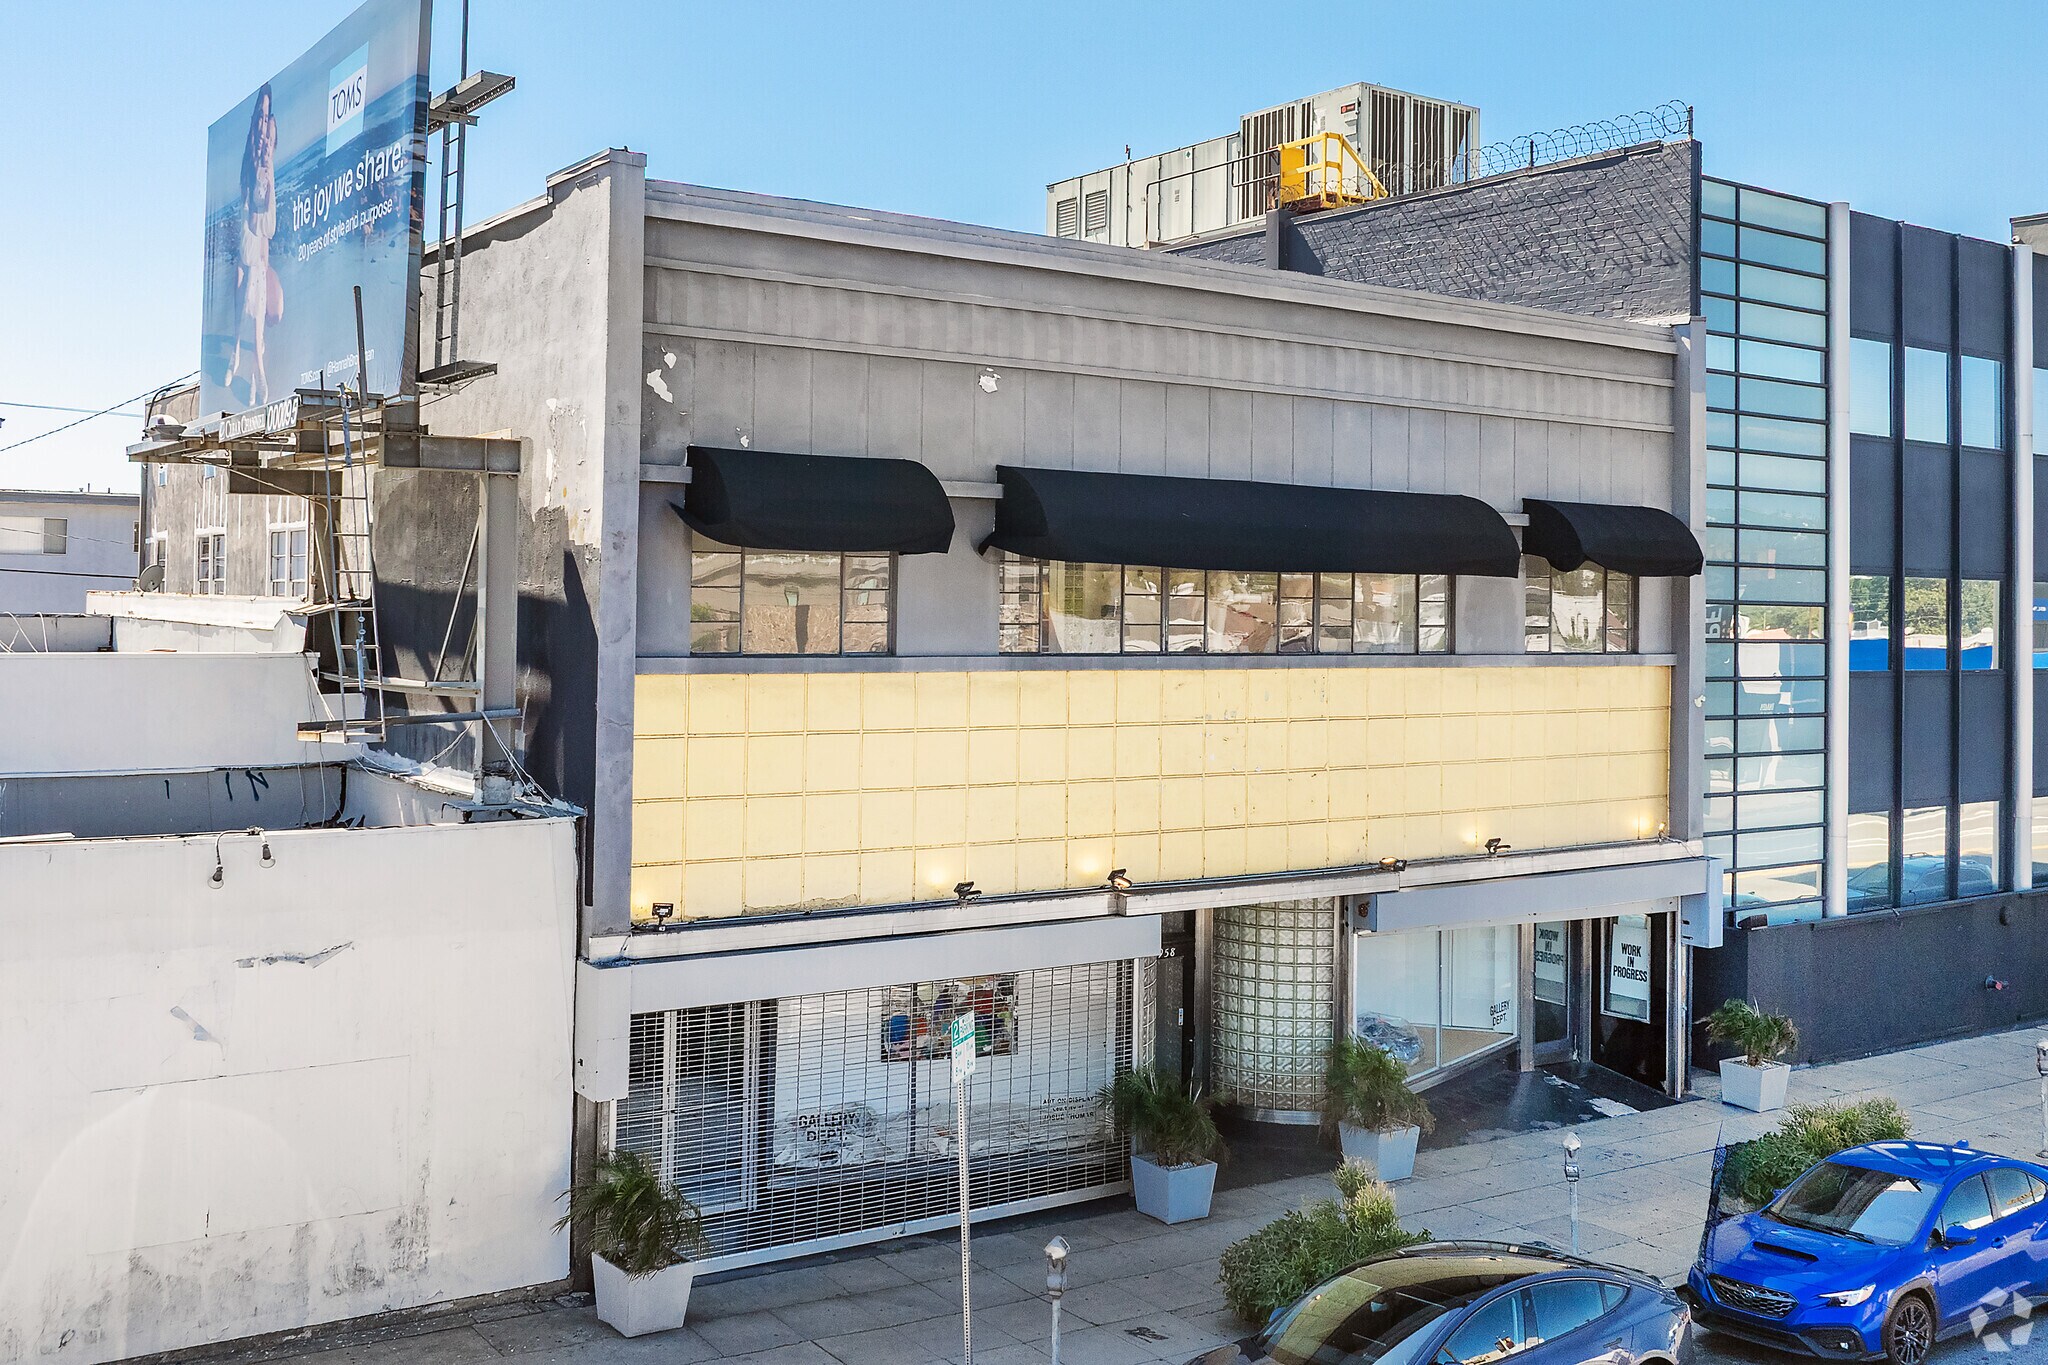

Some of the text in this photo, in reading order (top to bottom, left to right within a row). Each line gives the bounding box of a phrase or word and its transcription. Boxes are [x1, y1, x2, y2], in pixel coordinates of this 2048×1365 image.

[332, 76, 362, 124] TOMS
[293, 142, 404, 232] the joy we share.
[298, 198, 393, 262] 20 years of style and purpose
[1621, 942, 1642, 957] WORK
[1627, 955, 1635, 968] IN
[1613, 965, 1648, 983] PROGRESS
[1490, 999, 1511, 1016] GALLERY
